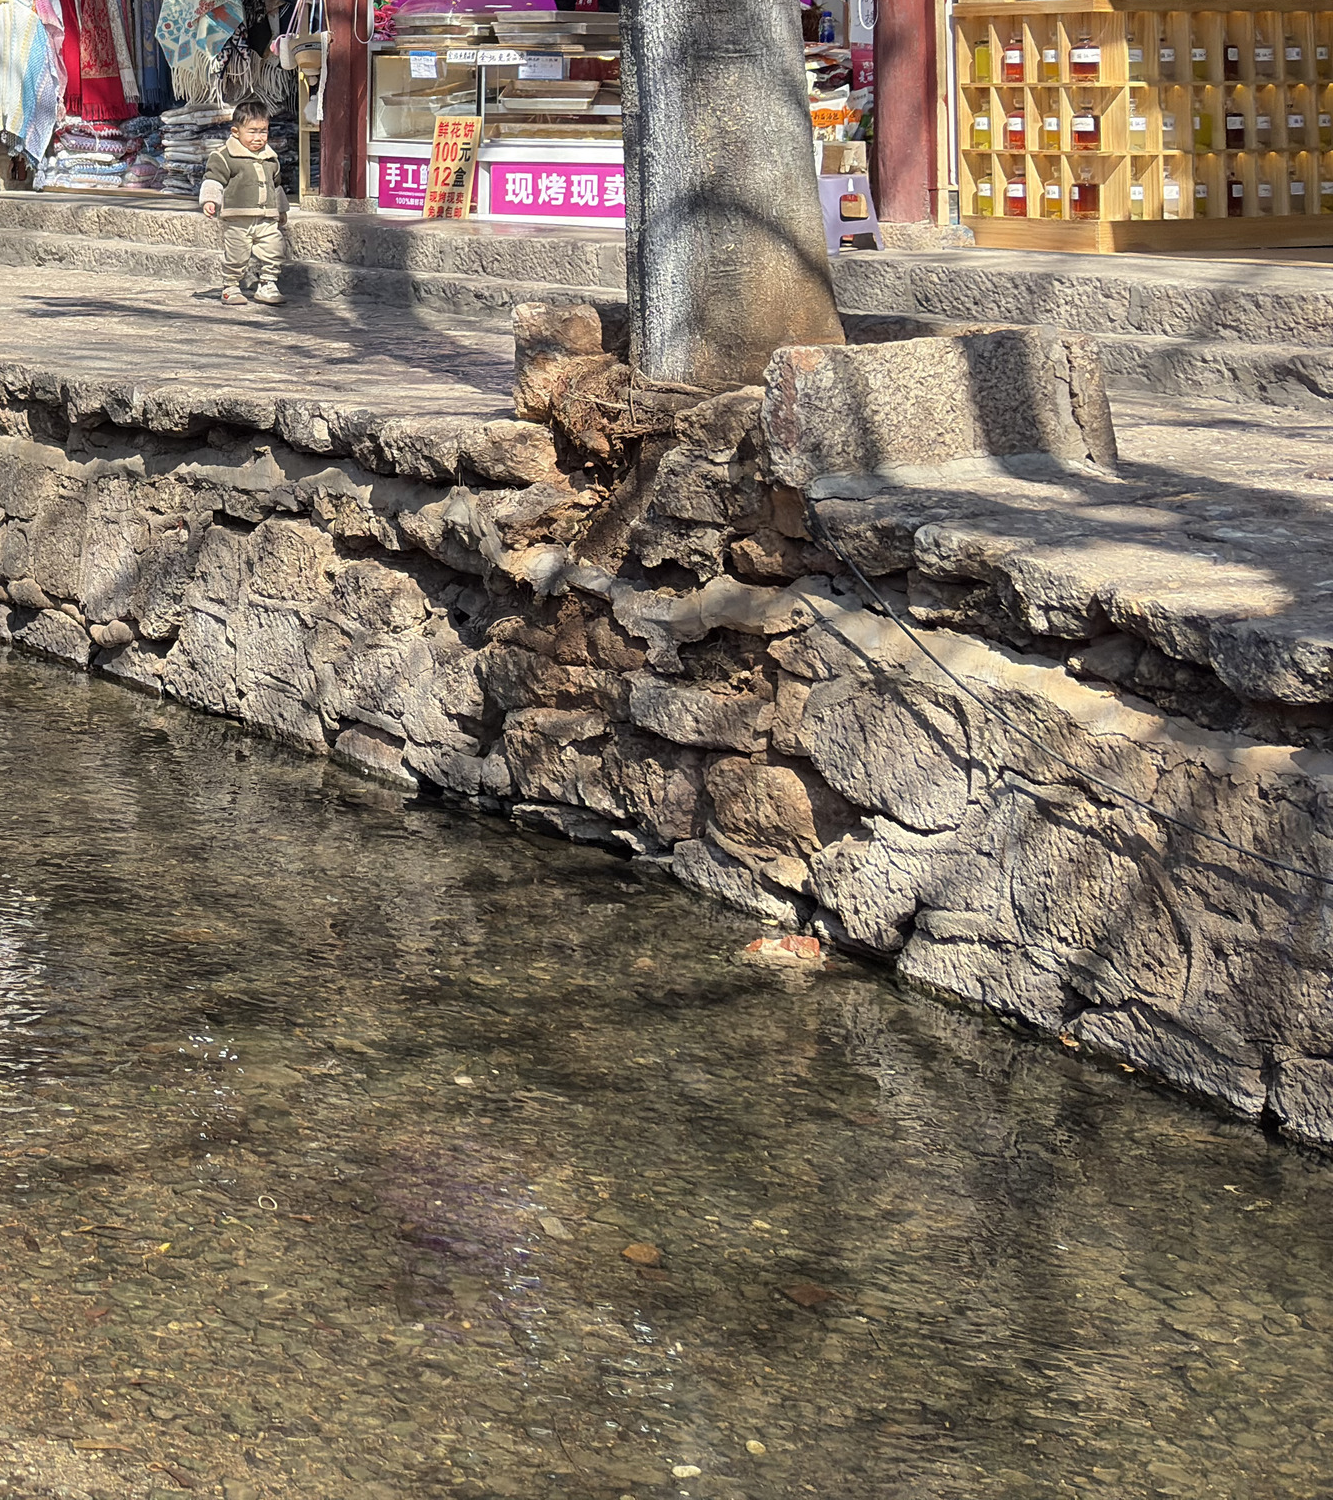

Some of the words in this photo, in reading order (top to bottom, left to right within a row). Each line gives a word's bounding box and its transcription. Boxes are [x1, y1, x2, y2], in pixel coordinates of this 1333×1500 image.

[437, 121, 475, 140] 鲜花饼
[434, 141, 472, 163] 100元
[433, 166, 467, 188] 12盒
